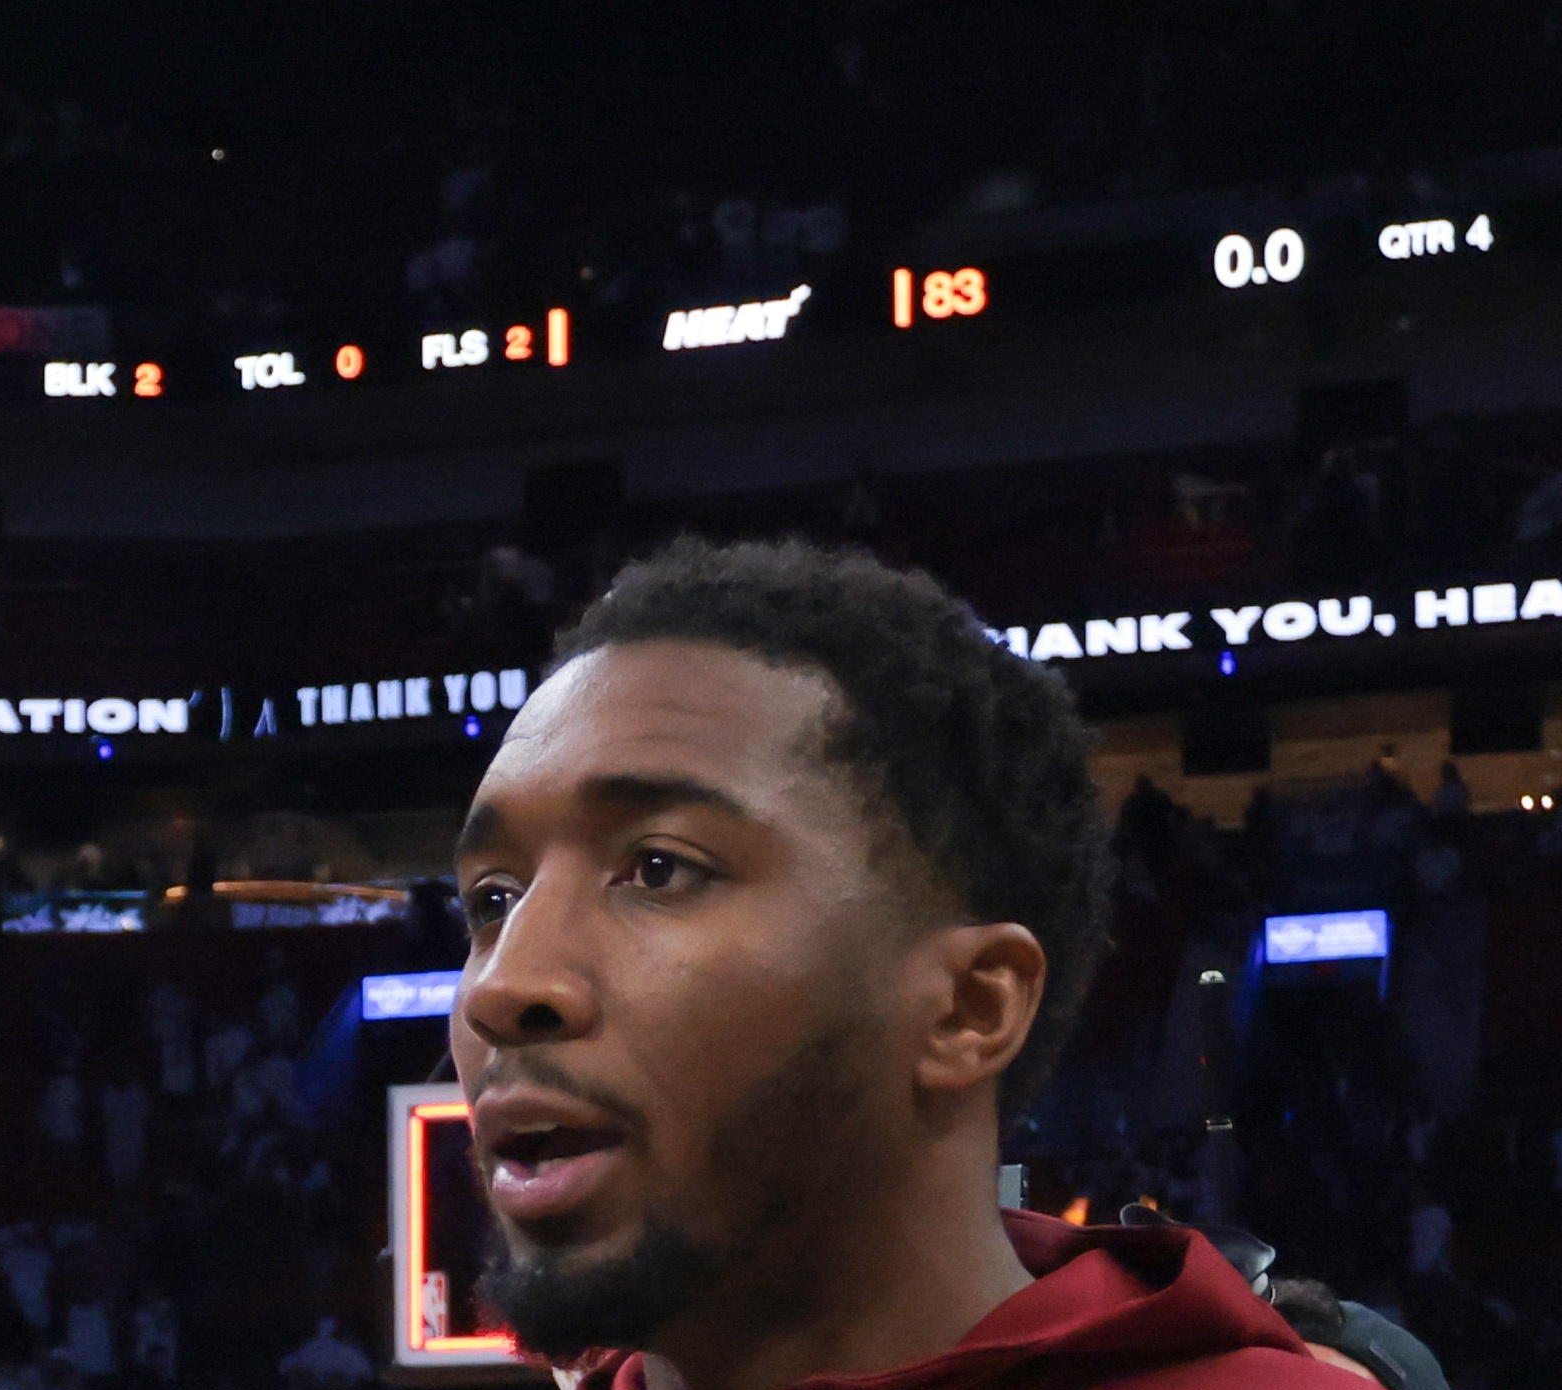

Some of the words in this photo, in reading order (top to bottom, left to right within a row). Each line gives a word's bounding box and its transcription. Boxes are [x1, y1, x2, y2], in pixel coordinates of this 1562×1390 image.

[1214, 229, 1304, 288] 0.0
[1379, 220, 1455, 259] QTR
[1466, 215, 1493, 251] 4
[663, 285, 811, 350] HEAT
[922, 268, 988, 318] 83
[45, 363, 116, 396] BLK
[134, 363, 162, 397] 2
[235, 352, 305, 389] TOL
[336, 345, 364, 379] 0
[422, 330, 488, 369] FLS
[505, 325, 533, 360] 2
[1211, 596, 1396, 644] YOU,
[297, 677, 430, 725] THANK
